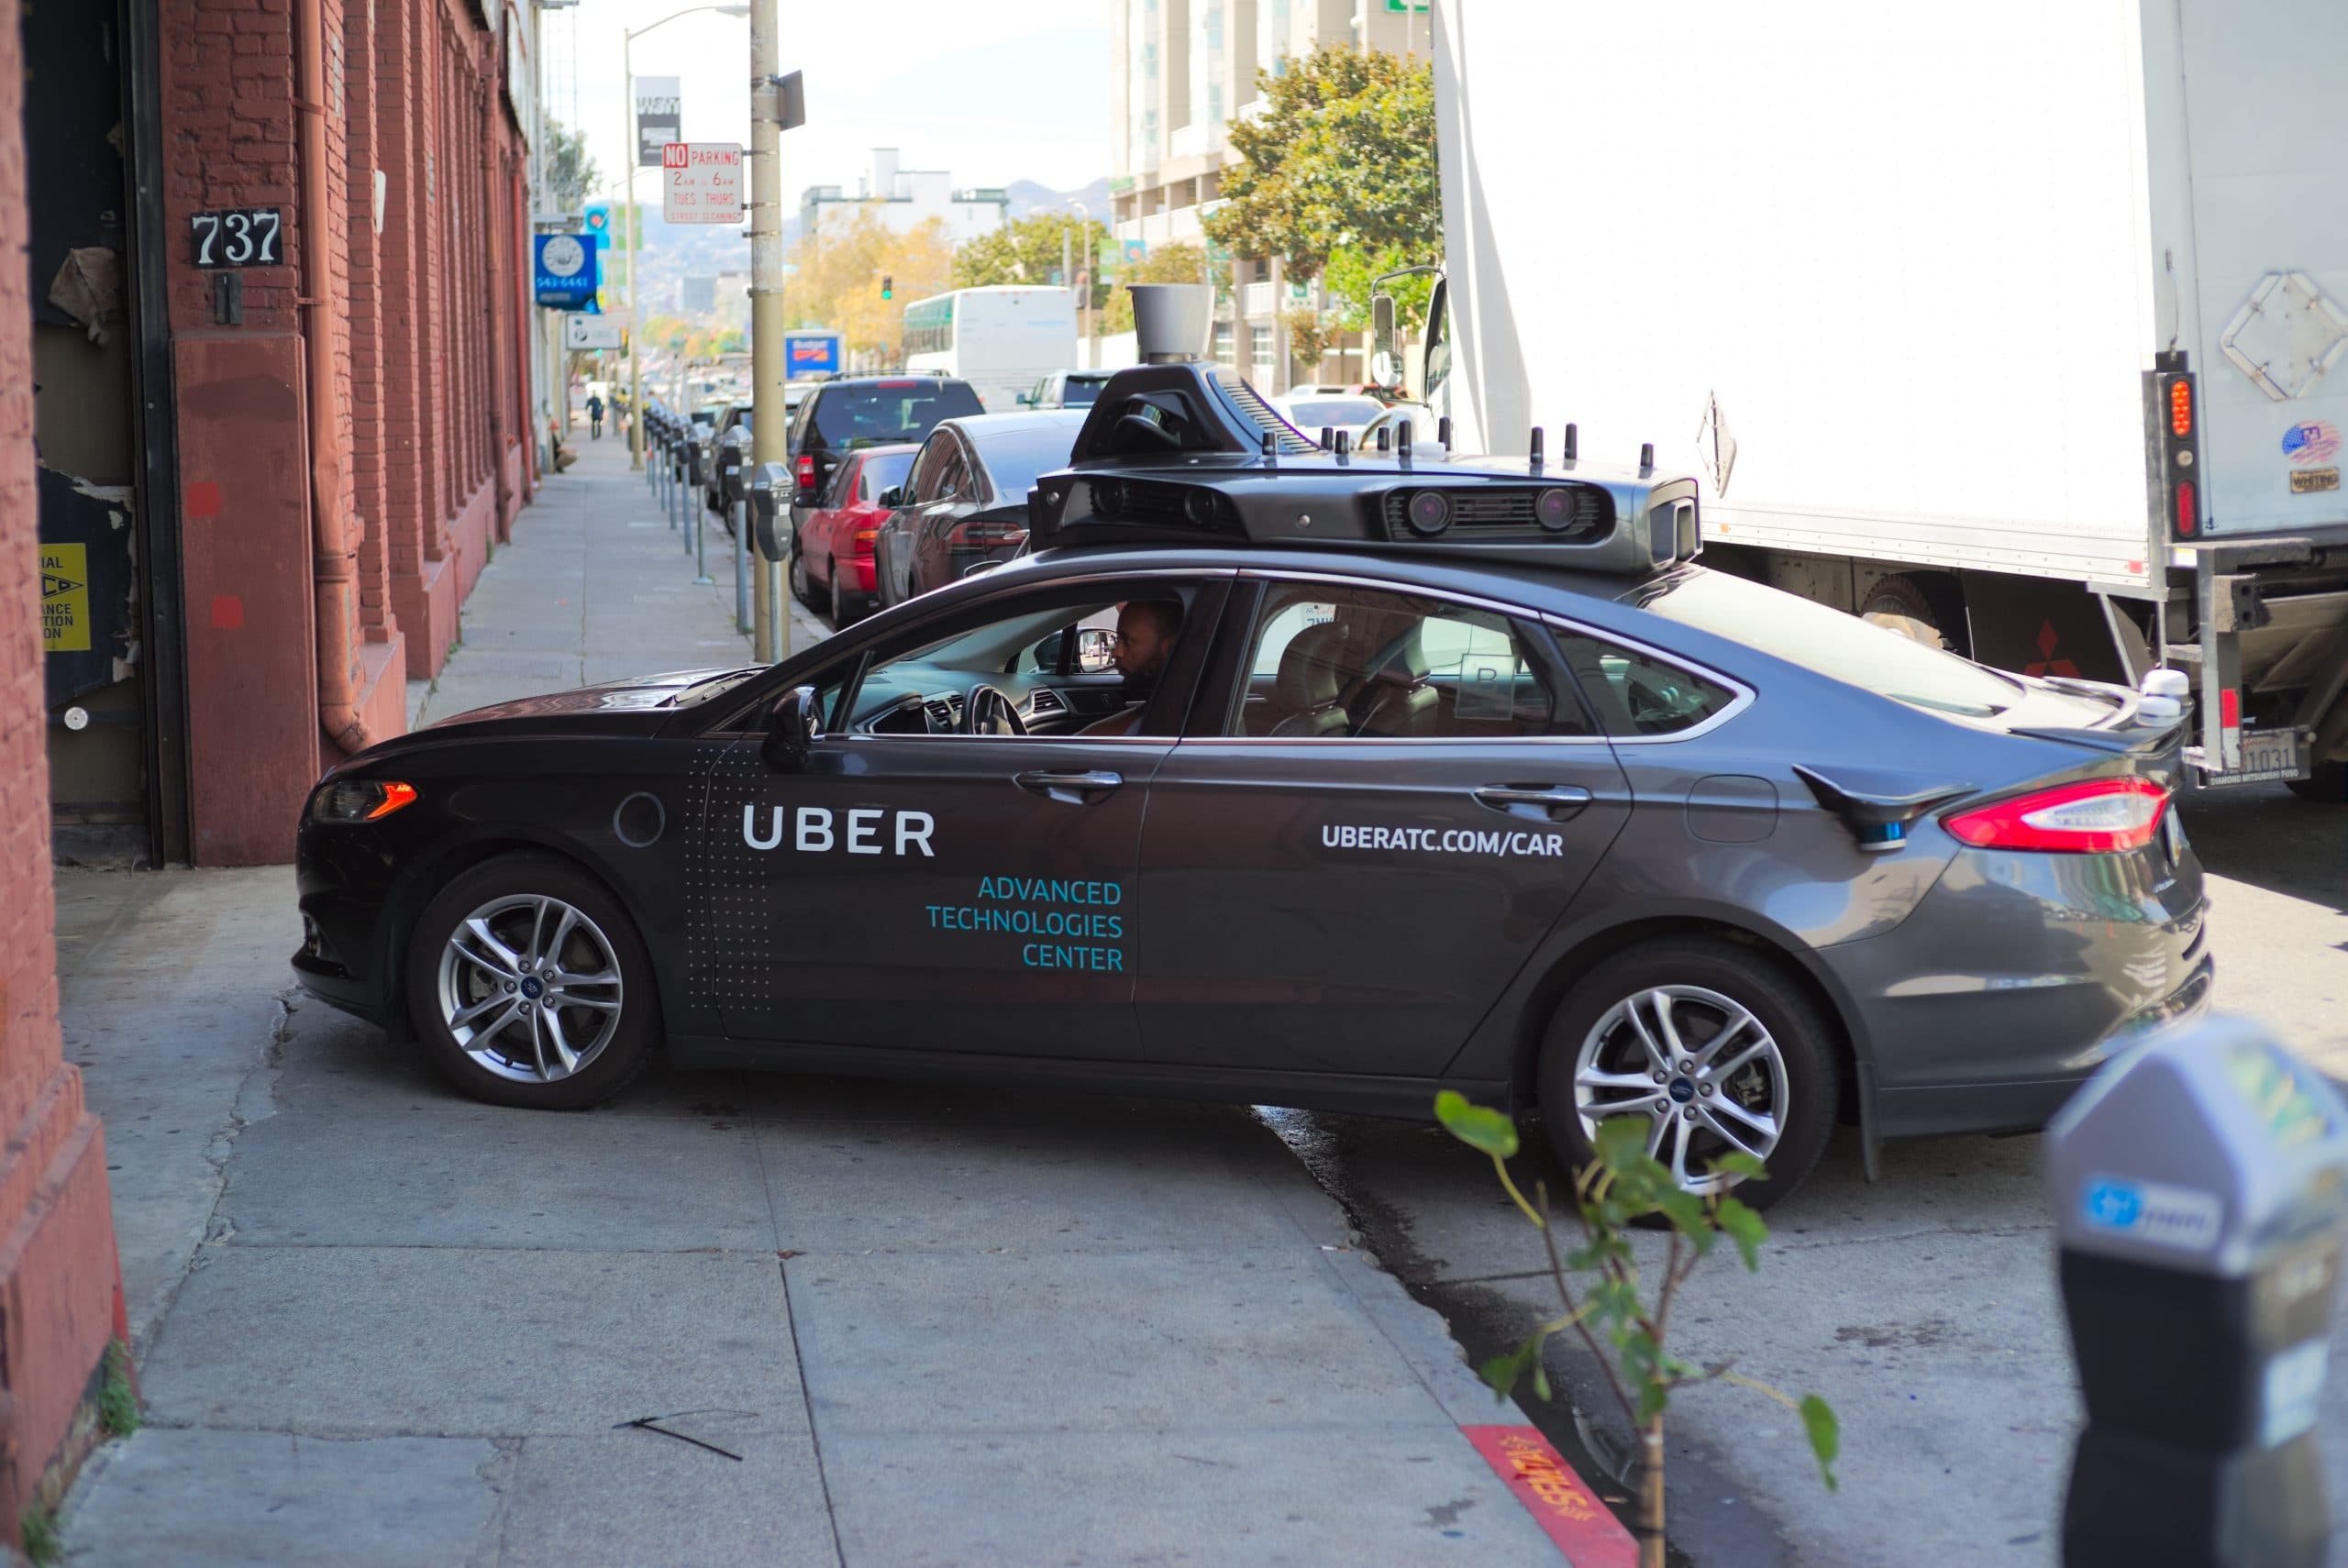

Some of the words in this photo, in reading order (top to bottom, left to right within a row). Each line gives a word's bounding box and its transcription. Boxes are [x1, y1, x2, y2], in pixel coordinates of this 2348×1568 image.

[665, 145, 687, 167] NO
[692, 150, 738, 166] PARKING
[674, 193, 697, 205] TUES
[705, 193, 735, 205] THURS
[192, 212, 279, 264] 737
[41, 557, 63, 569] IAL
[43, 615, 73, 627] TION
[43, 627, 61, 639] ON
[2246, 747, 2290, 770] 1031
[2210, 774, 2242, 786] DIAMOND
[2242, 770, 2280, 782] MITSUBISHI
[2281, 767, 2298, 778] FUSO
[743, 804, 935, 857] UBER
[1322, 824, 1564, 857] UBERATC.COM/CAR
[978, 876, 1122, 905] ADVANCED
[925, 905, 1123, 939] TECHNOLOGIES
[1023, 944, 1124, 972] CENTER
